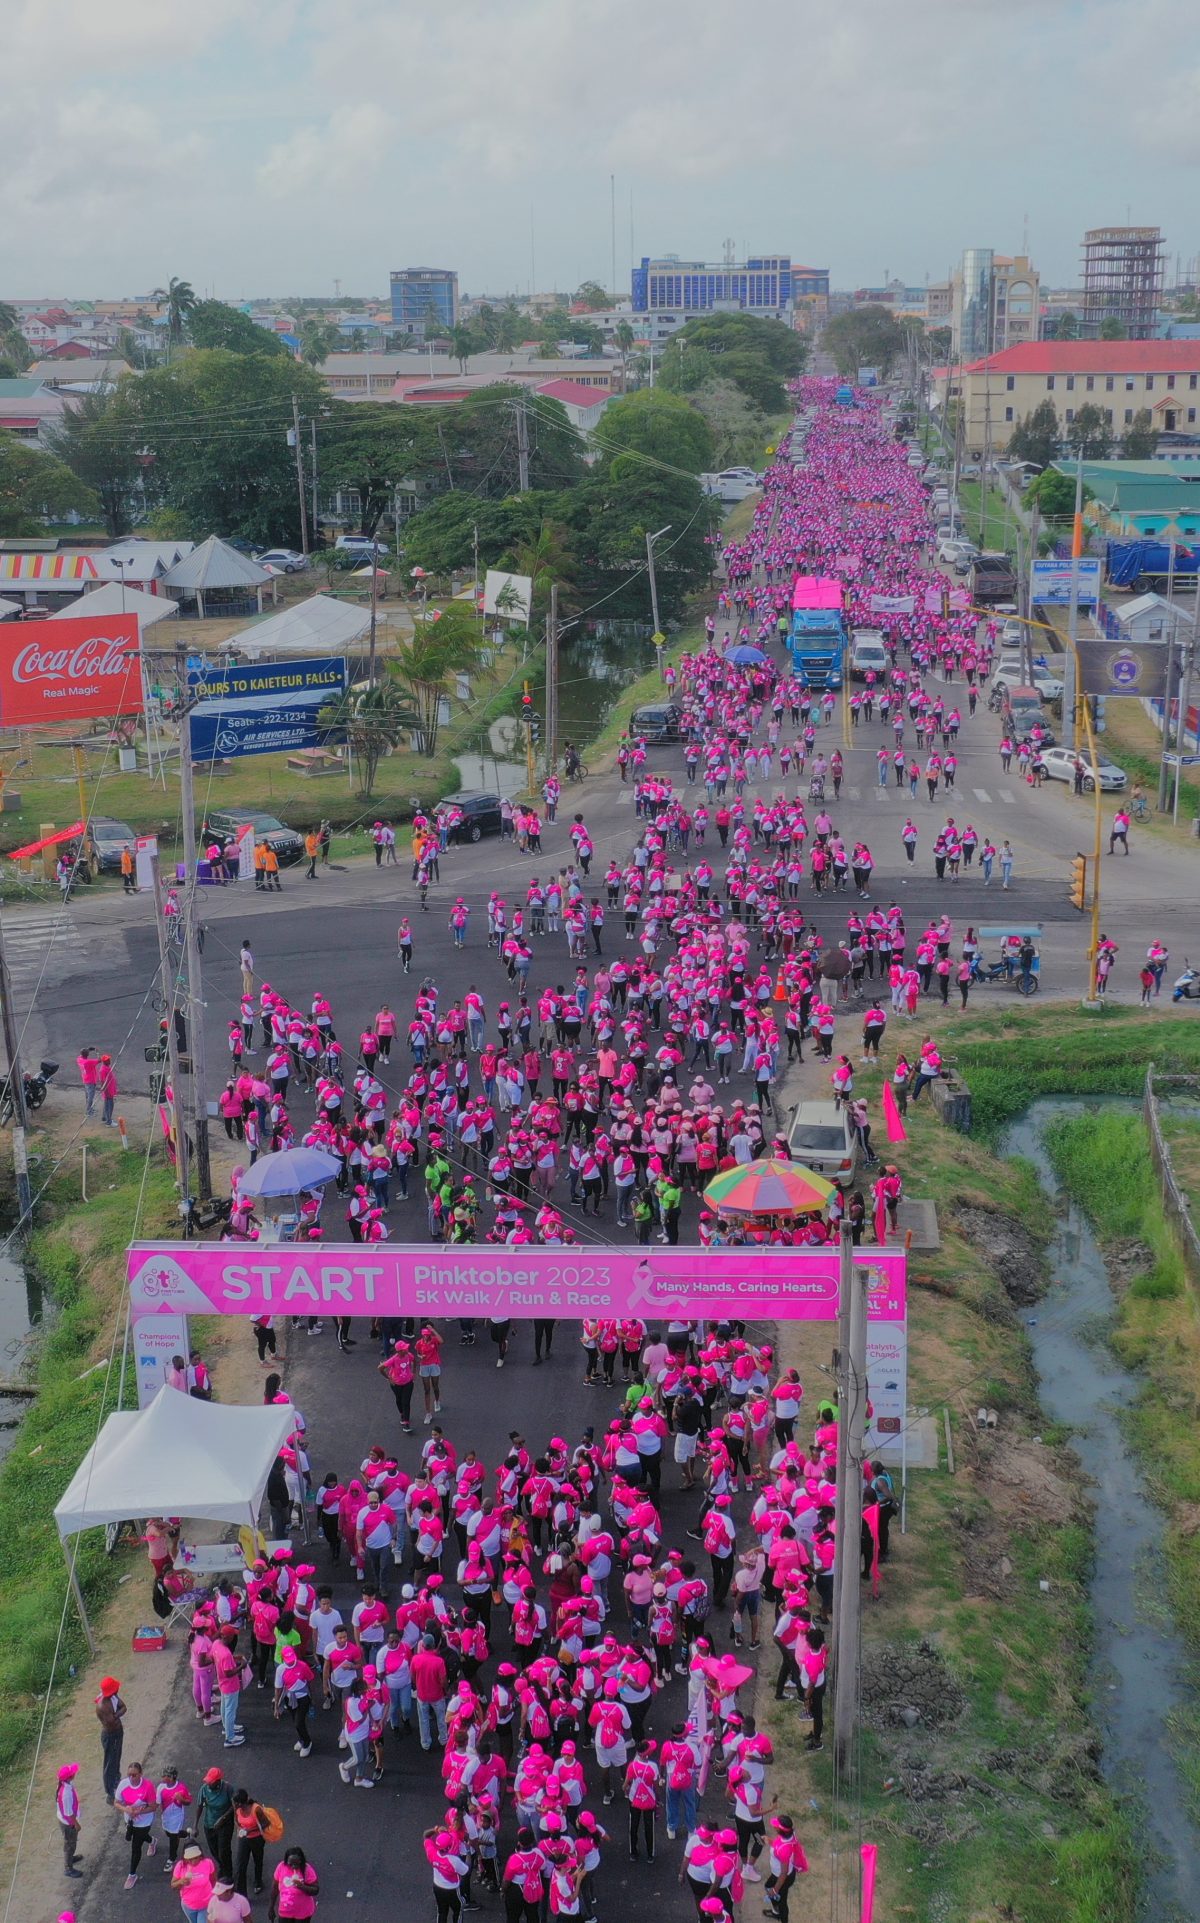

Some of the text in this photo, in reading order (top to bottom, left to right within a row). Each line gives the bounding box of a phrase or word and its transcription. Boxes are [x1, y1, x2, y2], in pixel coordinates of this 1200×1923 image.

[12, 636, 131, 683] Coca-Cola
[232, 680, 247, 692] TO
[250, 674, 303, 690] KAIETEUR
[305, 671, 336, 686] FALLS
[43, 685, 100, 698] Real Magic
[263, 712, 306, 724] 222-1234
[243, 734, 255, 742] AIR
[256, 729, 291, 740] SERVICES
[414, 1265, 611, 1287] Pinktober 2023
[222, 1265, 384, 1301] START
[656, 1282, 826, 1294] Many Hands, Caring Hearts.
[415, 1290, 439, 1304] 5K
[443, 1290, 490, 1305] Walk
[509, 1291, 544, 1305] Run
[549, 1291, 562, 1305] &
[567, 1291, 612, 1306] Race
[138, 1333, 180, 1341] Champions
[155, 1340, 175, 1348] Hope
[866, 1343, 897, 1351] atalysts
[869, 1351, 900, 1359] Change
